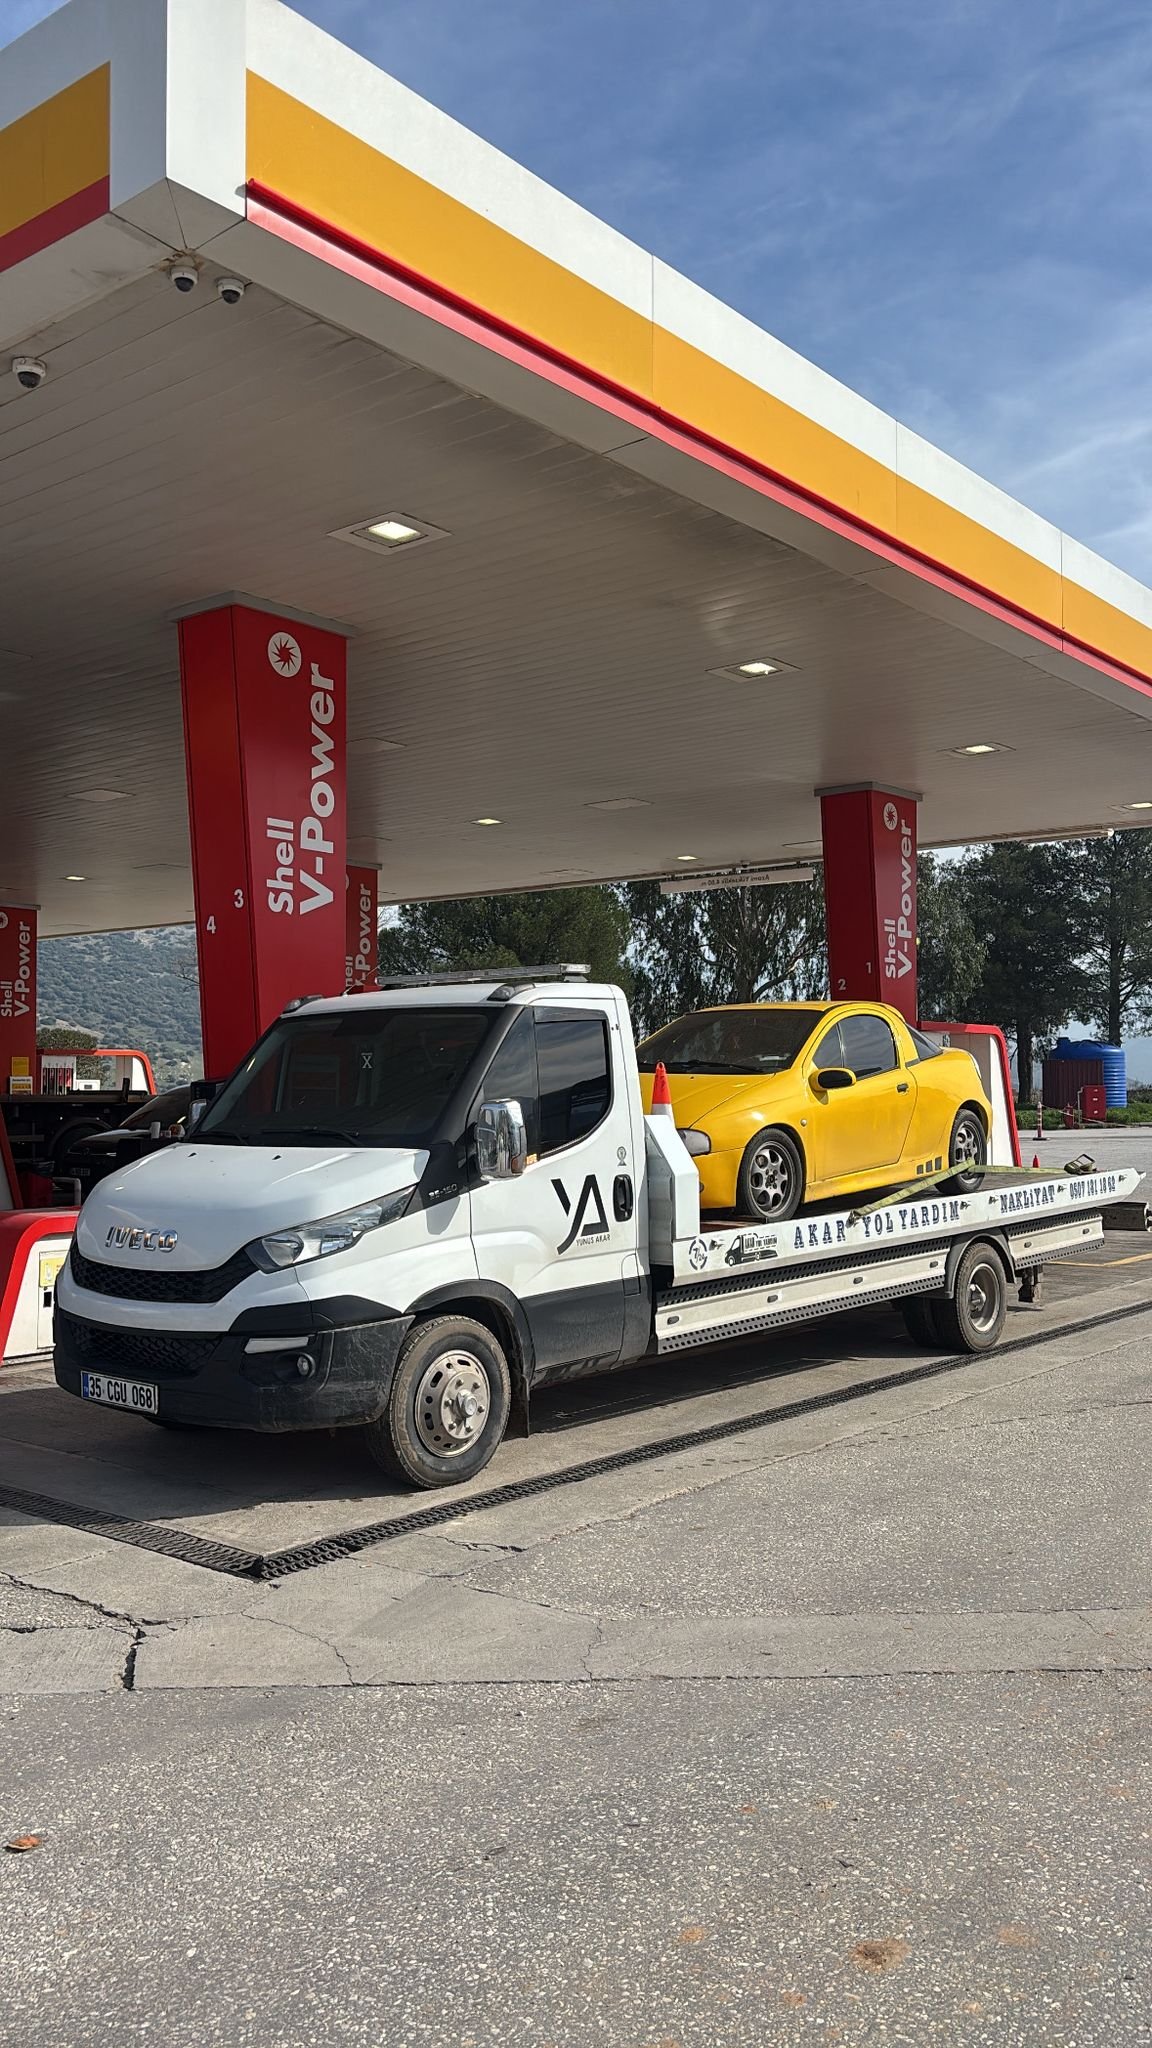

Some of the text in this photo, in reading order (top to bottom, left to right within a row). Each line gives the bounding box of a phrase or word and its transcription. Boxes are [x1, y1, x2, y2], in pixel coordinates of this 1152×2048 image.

[300, 662, 335, 916] V-Power
[267, 817, 295, 916] Shell
[234, 888, 244, 909] 3
[898, 819, 913, 979] V-Power
[206, 915, 217, 934] 4
[884, 919, 896, 979] Shell
[15, 921, 31, 1017] V-Power
[838, 979, 847, 990] 2
[866, 962, 872, 973] 1
[1, 981, 12, 1017] Shell
[105, 1226, 179, 1252] IVECO
[595, 1234, 611, 1243] AKAR
[793, 1220, 846, 1249] AKAR
[862, 1212, 893, 1238] YOL
[899, 1200, 960, 1230] YARDIM
[89, 1376, 102, 1398] 35
[107, 1380, 127, 1403] CGU
[132, 1385, 153, 1409] 068
